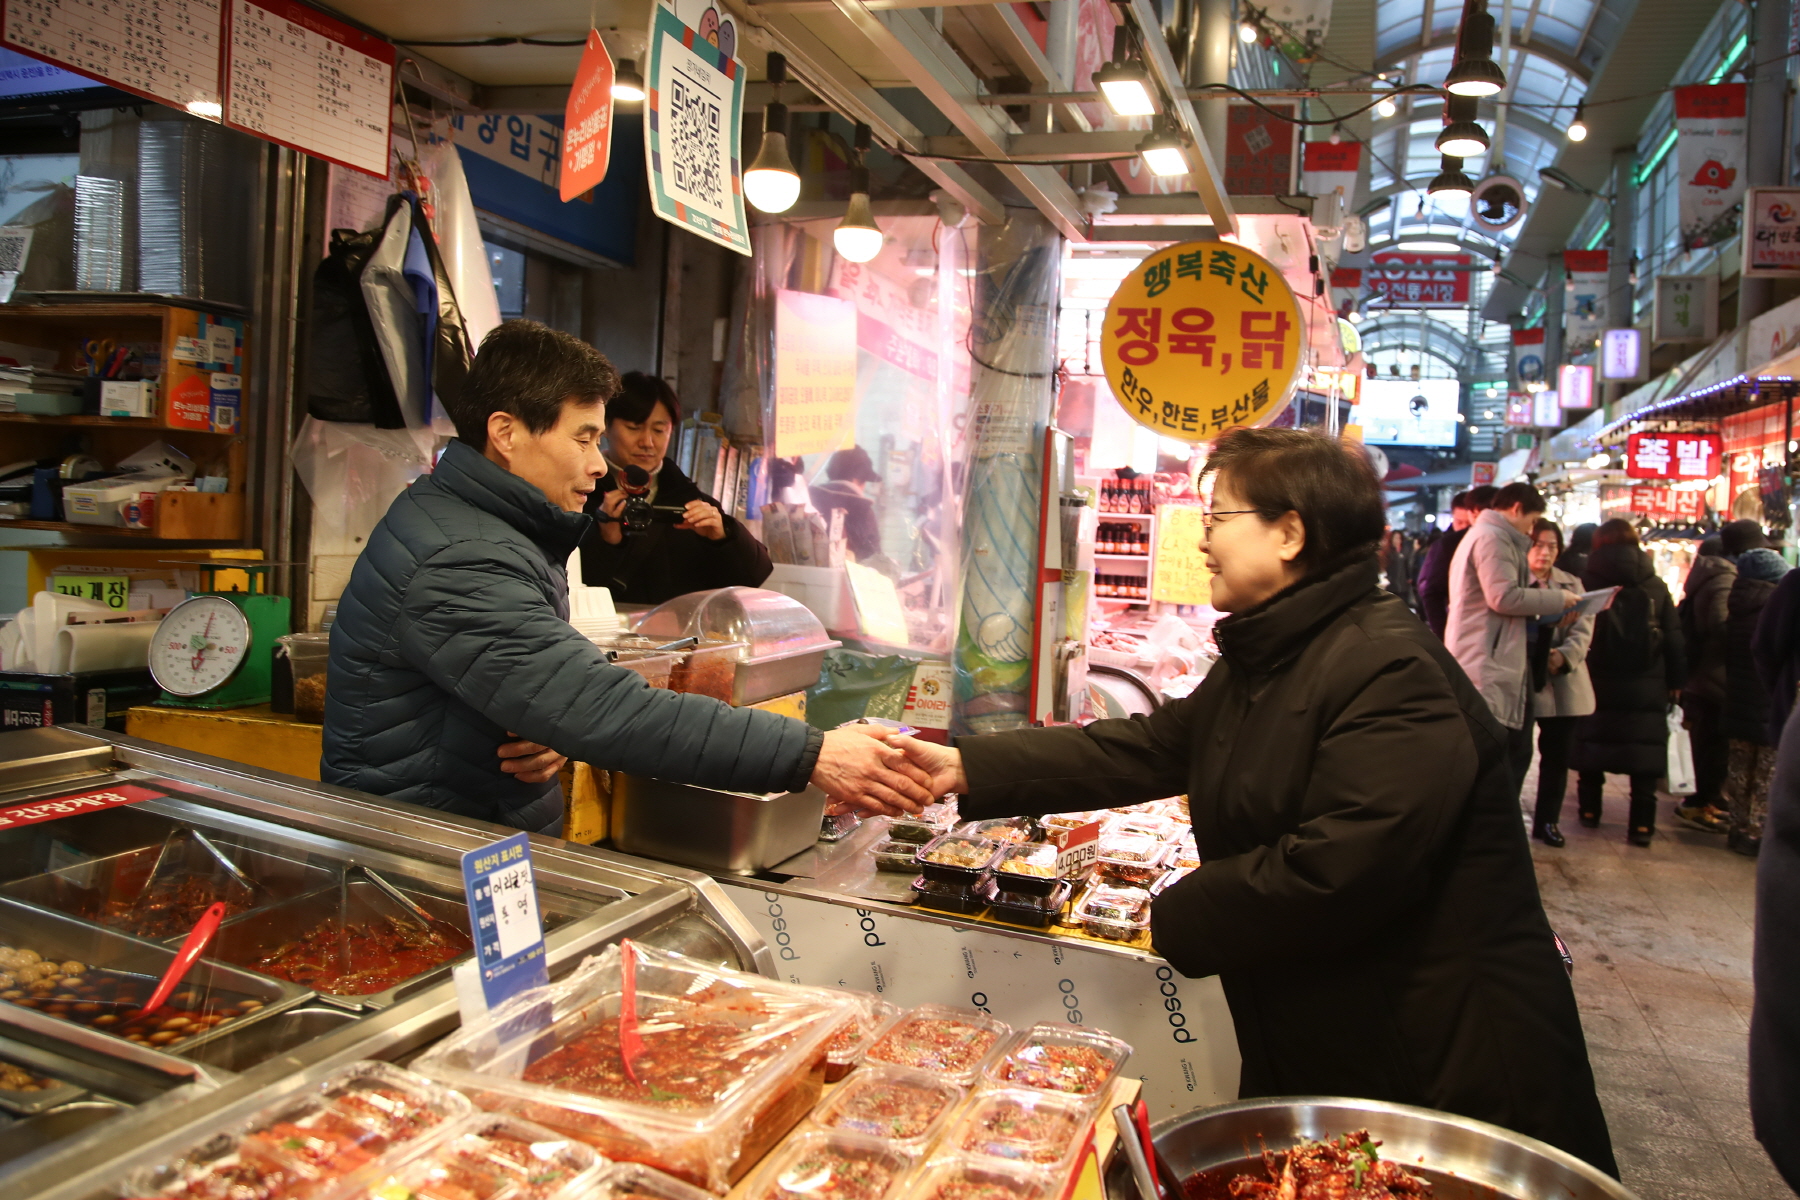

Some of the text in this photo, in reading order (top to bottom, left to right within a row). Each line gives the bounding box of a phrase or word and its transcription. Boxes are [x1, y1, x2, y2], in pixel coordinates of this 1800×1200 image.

[1143, 250, 1269, 305] 행복축산
[1633, 488, 1699, 513] 국내산
[5, 792, 128, 819] 간장게장
[474, 844, 524, 874] 원산지 표시판
[1058, 844, 1096, 871] 4,000원
[479, 914, 496, 929] 원산지
[765, 891, 801, 961] posco
[856, 908, 886, 947] pos
[1058, 979, 1084, 1026] sco
[1156, 966, 1198, 1044] posco
